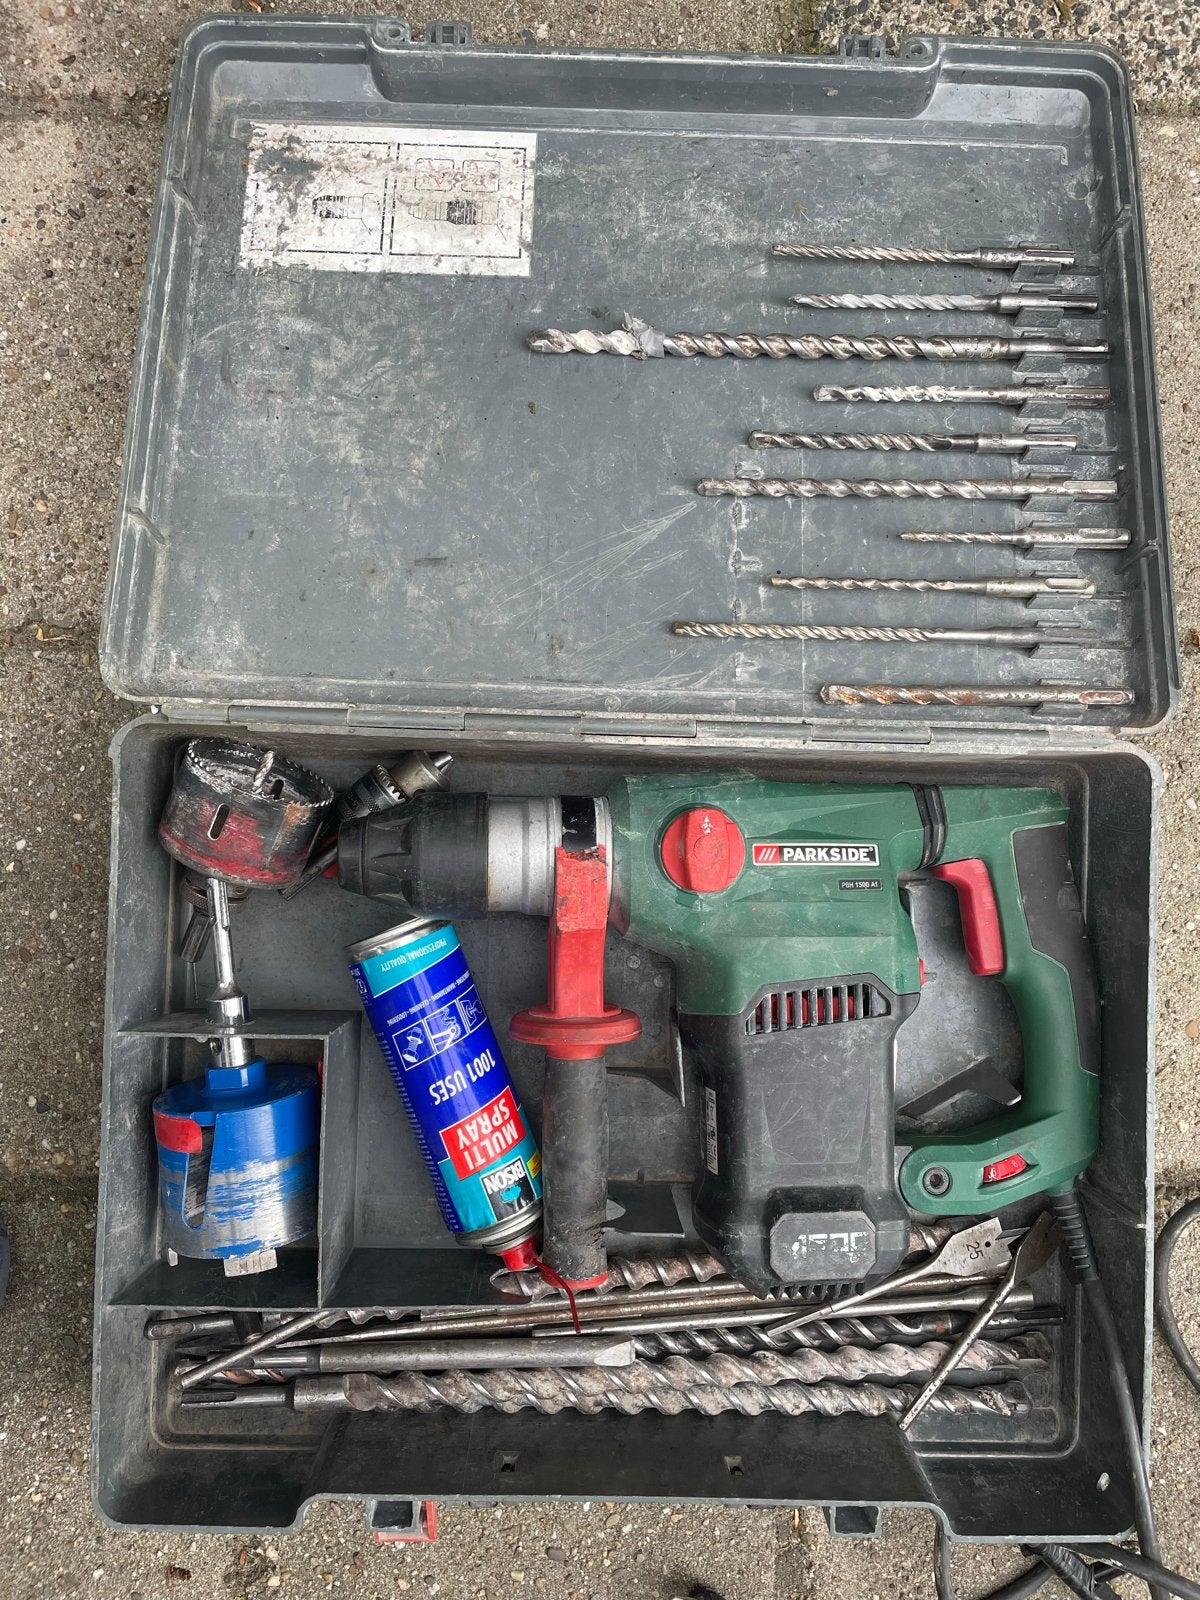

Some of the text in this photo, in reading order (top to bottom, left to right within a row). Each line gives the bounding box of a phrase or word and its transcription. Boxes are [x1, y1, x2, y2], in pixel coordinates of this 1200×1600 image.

[783, 847, 871, 862] PARKSIDE
[841, 881, 854, 889] PBH
[406, 937, 448, 962] PROFESSIONAL
[380, 957, 407, 972] QUALITY
[409, 998, 430, 1015] CLEANING
[386, 1010, 408, 1026] LOOSENING
[429, 1048, 496, 1106] 1001 USES
[456, 1097, 511, 1151] SPRAY
[463, 1118, 519, 1172] MULTI
[483, 1159, 527, 1195] BISON
[965, 1241, 984, 1260] 25
